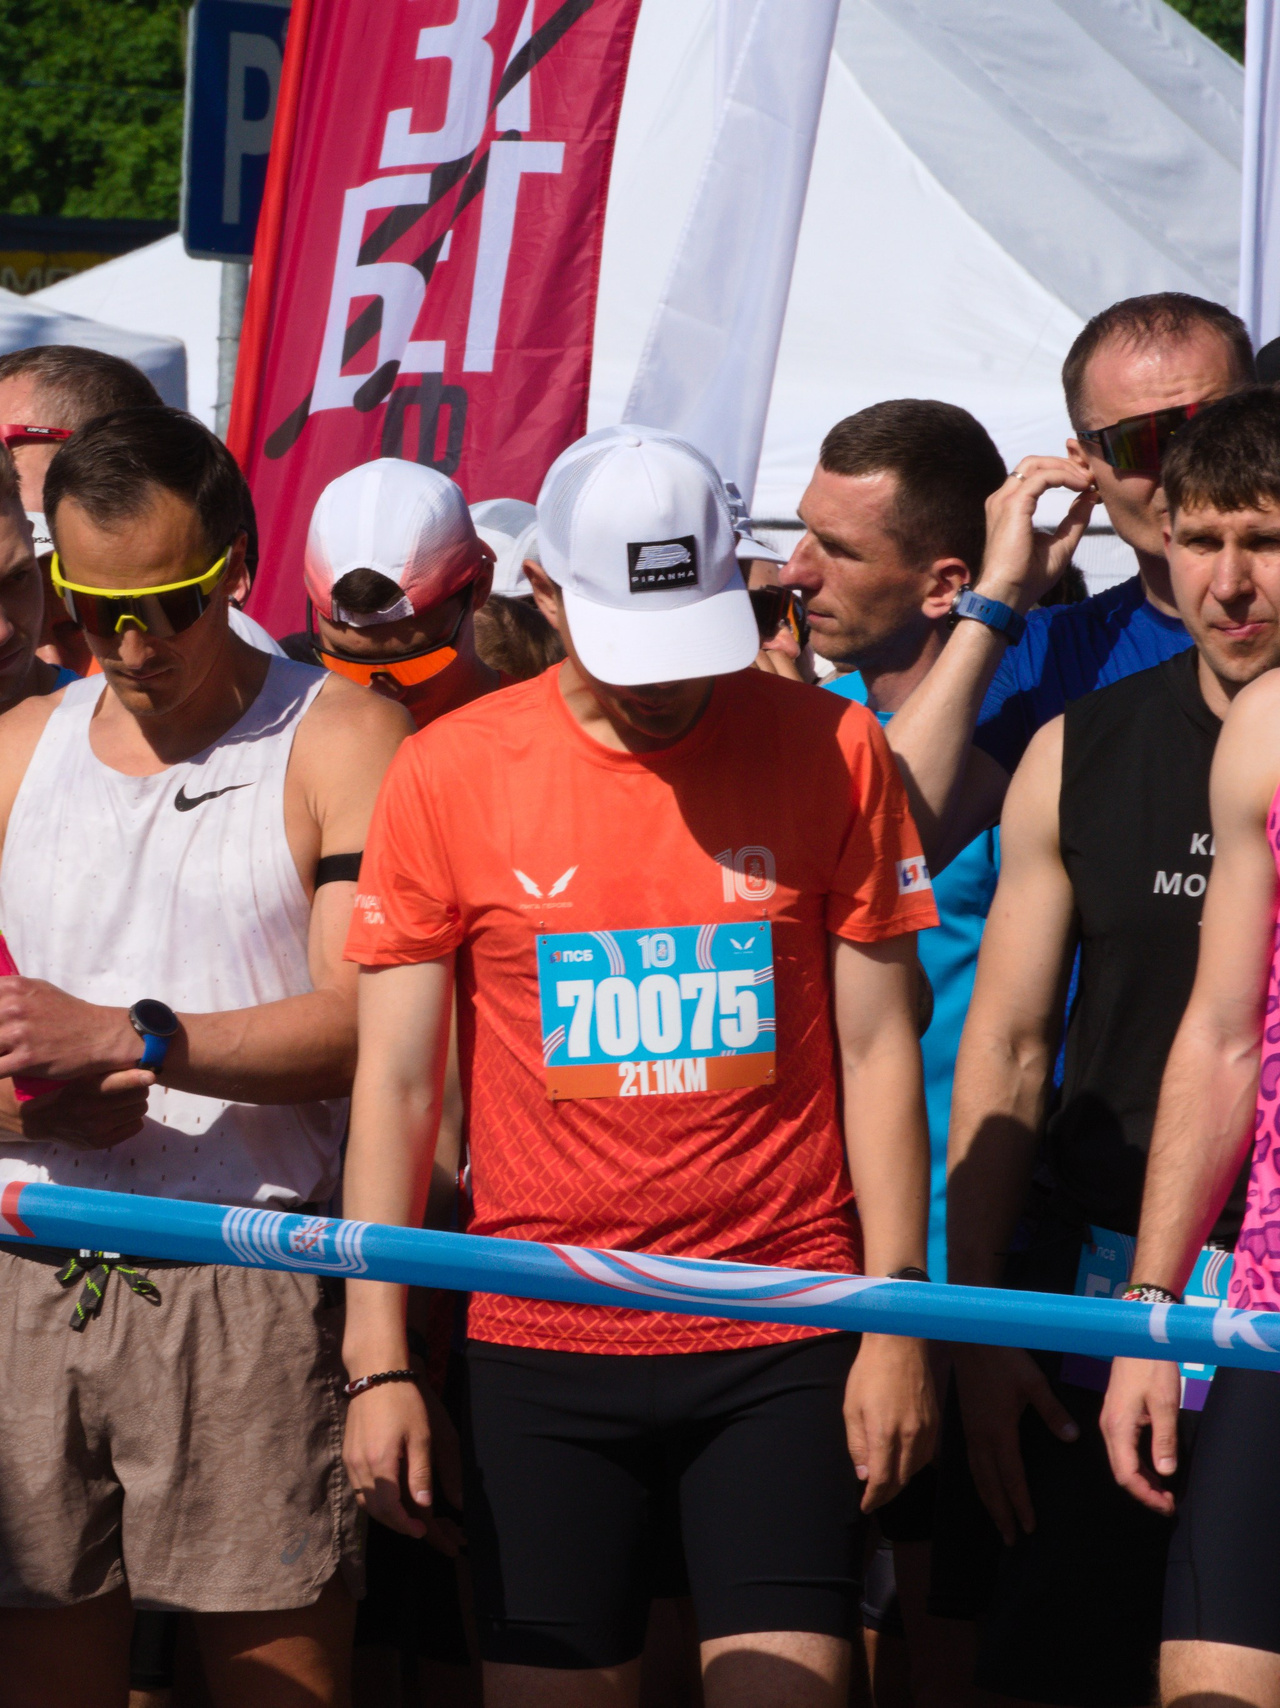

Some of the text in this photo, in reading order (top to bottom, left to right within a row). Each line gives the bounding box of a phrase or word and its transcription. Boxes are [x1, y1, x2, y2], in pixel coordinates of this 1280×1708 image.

[223, 31, 284, 225] P
[631, 570, 696, 583] PIRANHA
[714, 846, 777, 903] 10
[1153, 870, 1207, 897] MO
[563, 949, 594, 963] ПСБ
[636, 933, 676, 969] 10
[556, 969, 759, 1058] 70075
[619, 1057, 708, 1097] 21.1KM
